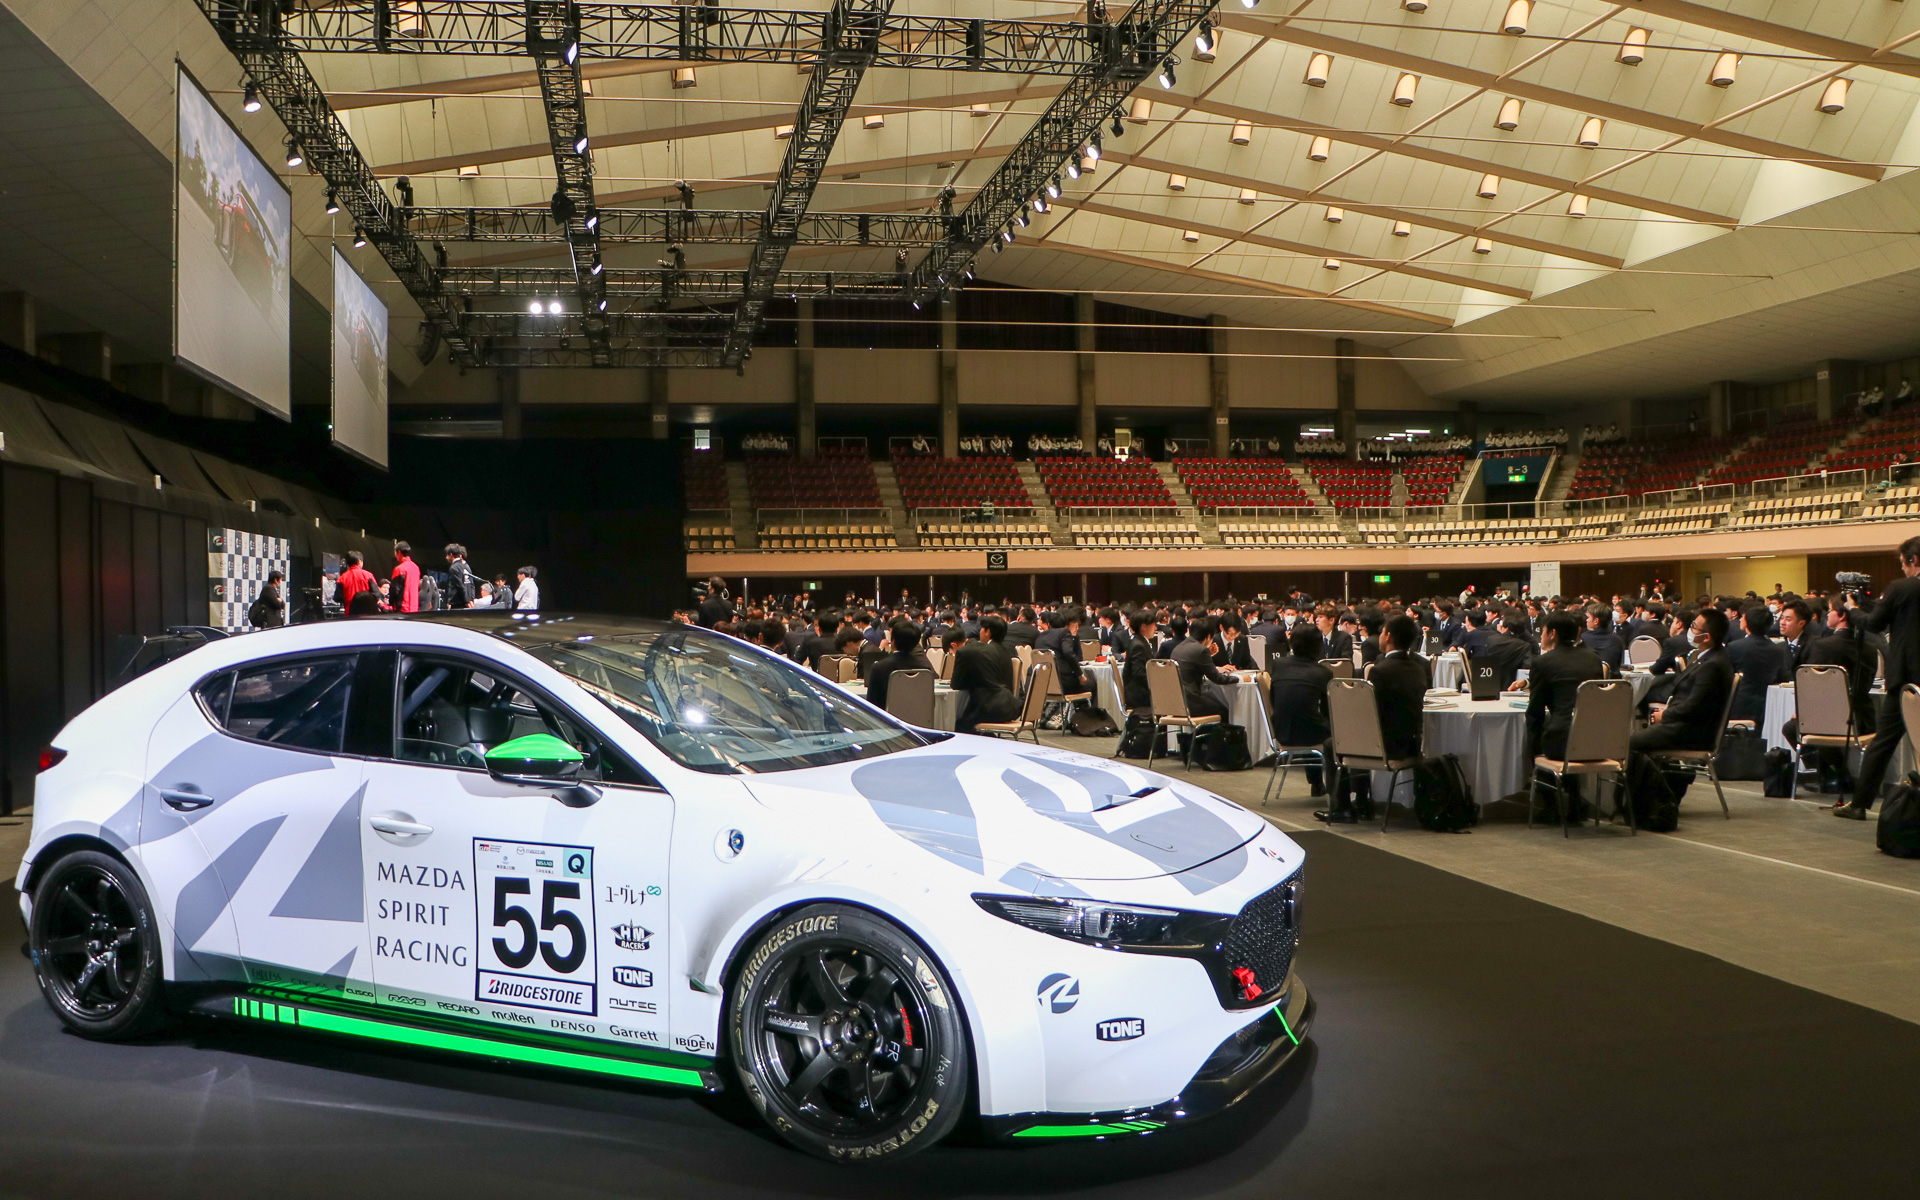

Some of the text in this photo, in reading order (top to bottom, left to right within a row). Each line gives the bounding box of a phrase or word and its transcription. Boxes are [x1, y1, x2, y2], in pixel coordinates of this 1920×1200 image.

[1431, 636, 1439, 644] 30
[1272, 651, 1281, 660] 19
[1480, 667, 1493, 678] 20
[568, 853, 584, 875] Q
[377, 861, 466, 891] MAZDA
[605, 884, 647, 906] ユーグレナ
[377, 898, 450, 926] SPIRIT
[491, 876, 587, 974] 55
[376, 935, 467, 967] RACING
[621, 940, 646, 950] RACERS
[742, 915, 838, 990] BRIDGESTONE
[614, 967, 651, 986] TONE
[388, 993, 427, 1007] RAYS
[488, 979, 583, 1005] BRIDGESTONE
[437, 1001, 480, 1015] RECARO
[492, 1010, 536, 1025] molten
[550, 1018, 596, 1034] DENSO
[609, 1025, 659, 1042] Garrett
[1099, 1019, 1142, 1039] TONE
[675, 1037, 715, 1051] IBIDEN
[887, 1040, 901, 1062] FR
[828, 1098, 939, 1159] POTENZA
